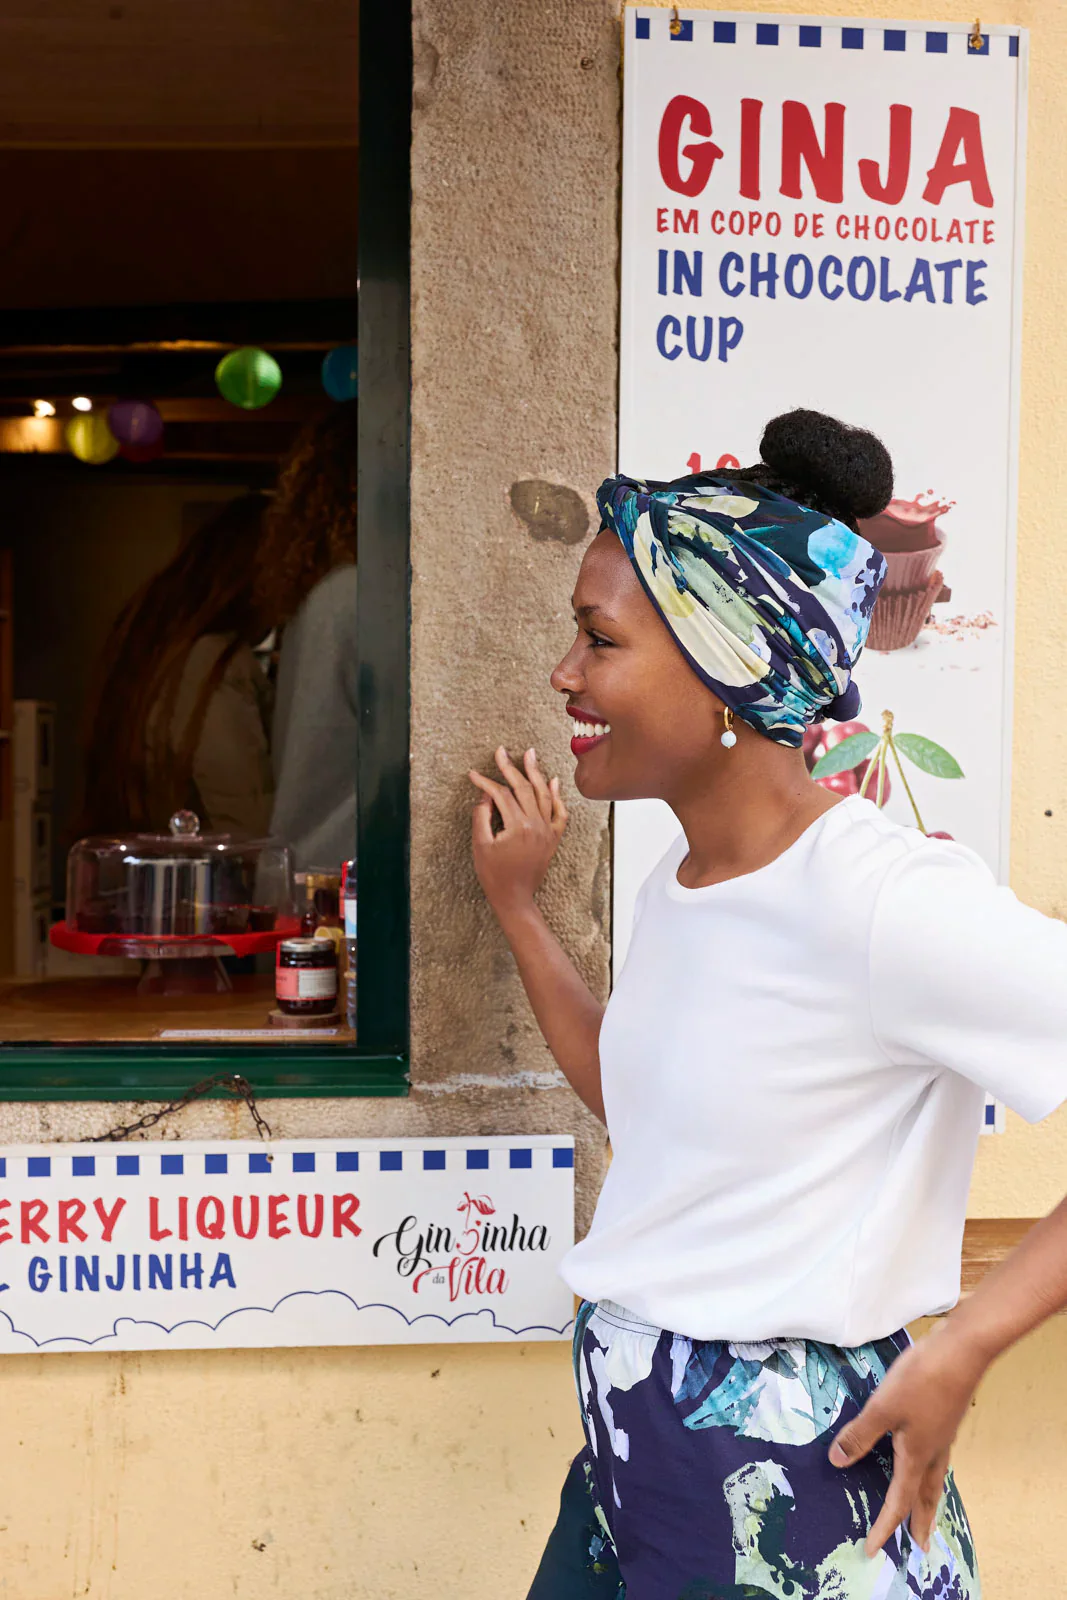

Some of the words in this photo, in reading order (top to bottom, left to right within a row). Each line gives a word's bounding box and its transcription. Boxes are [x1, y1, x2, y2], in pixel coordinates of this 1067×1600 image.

[657, 93, 995, 209] GINJA
[655, 207, 700, 236] EM
[710, 209, 782, 238] COPO
[793, 212, 825, 239] DE
[835, 213, 996, 246] CHOCOLATE
[657, 249, 703, 297] IN
[719, 251, 988, 306] CHOCOLATE
[656, 315, 744, 363] CUP
[148, 1192, 363, 1243] LIQUEUR
[27, 1251, 237, 1293] GINJINHA
[412, 1256, 510, 1302] Vila
[432, 1272, 446, 1285] da
